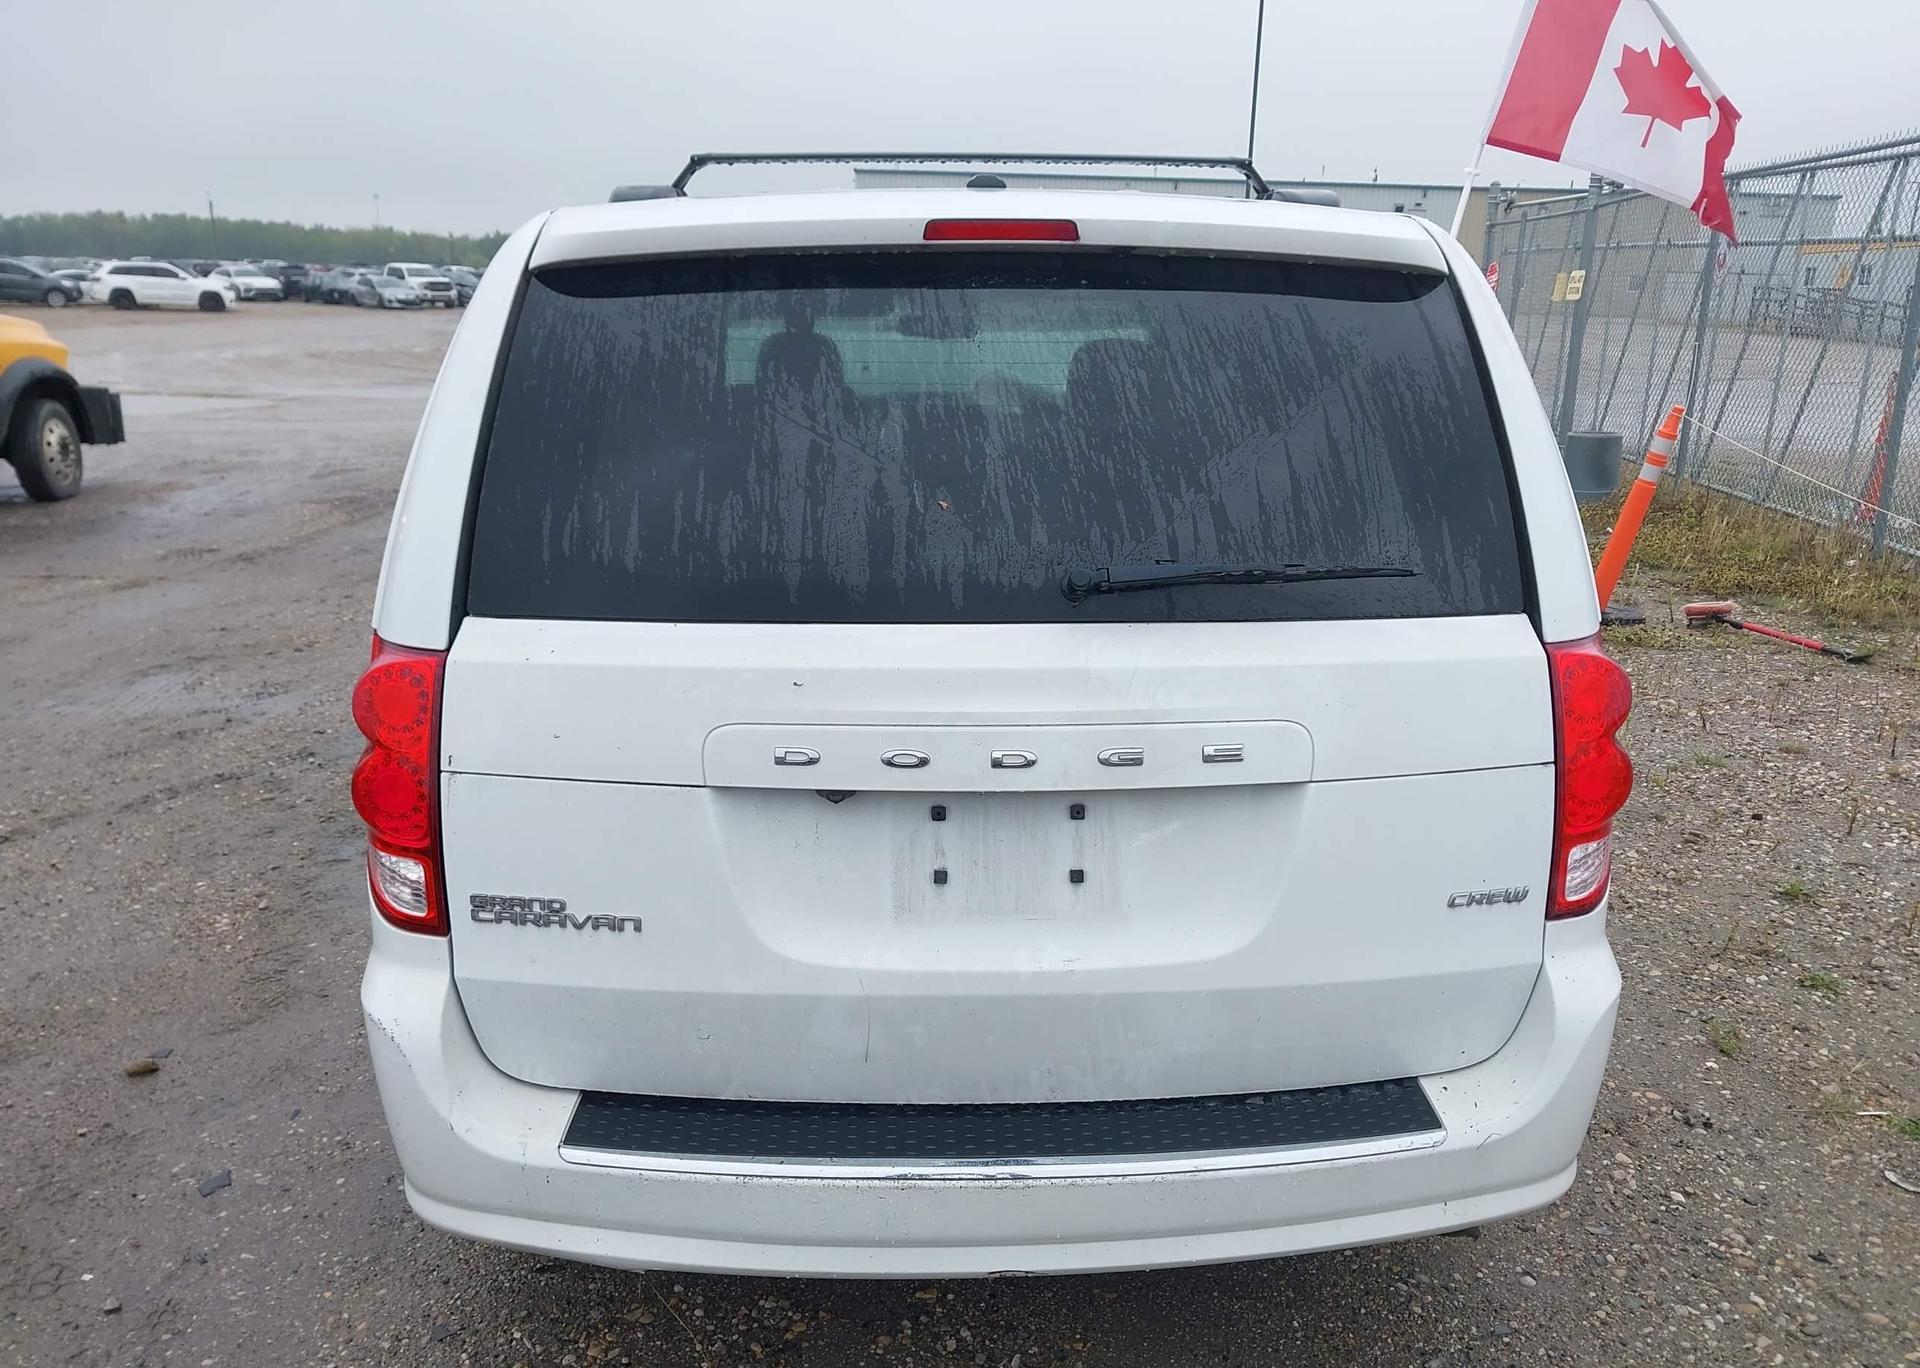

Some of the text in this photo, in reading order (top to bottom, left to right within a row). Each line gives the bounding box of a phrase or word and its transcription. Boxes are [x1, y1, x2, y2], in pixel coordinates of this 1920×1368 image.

[774, 743, 1245, 768] DODGE
[470, 893, 567, 913] GRAND
[1447, 886, 1530, 907] CREW
[470, 908, 643, 933] CARAVAN
